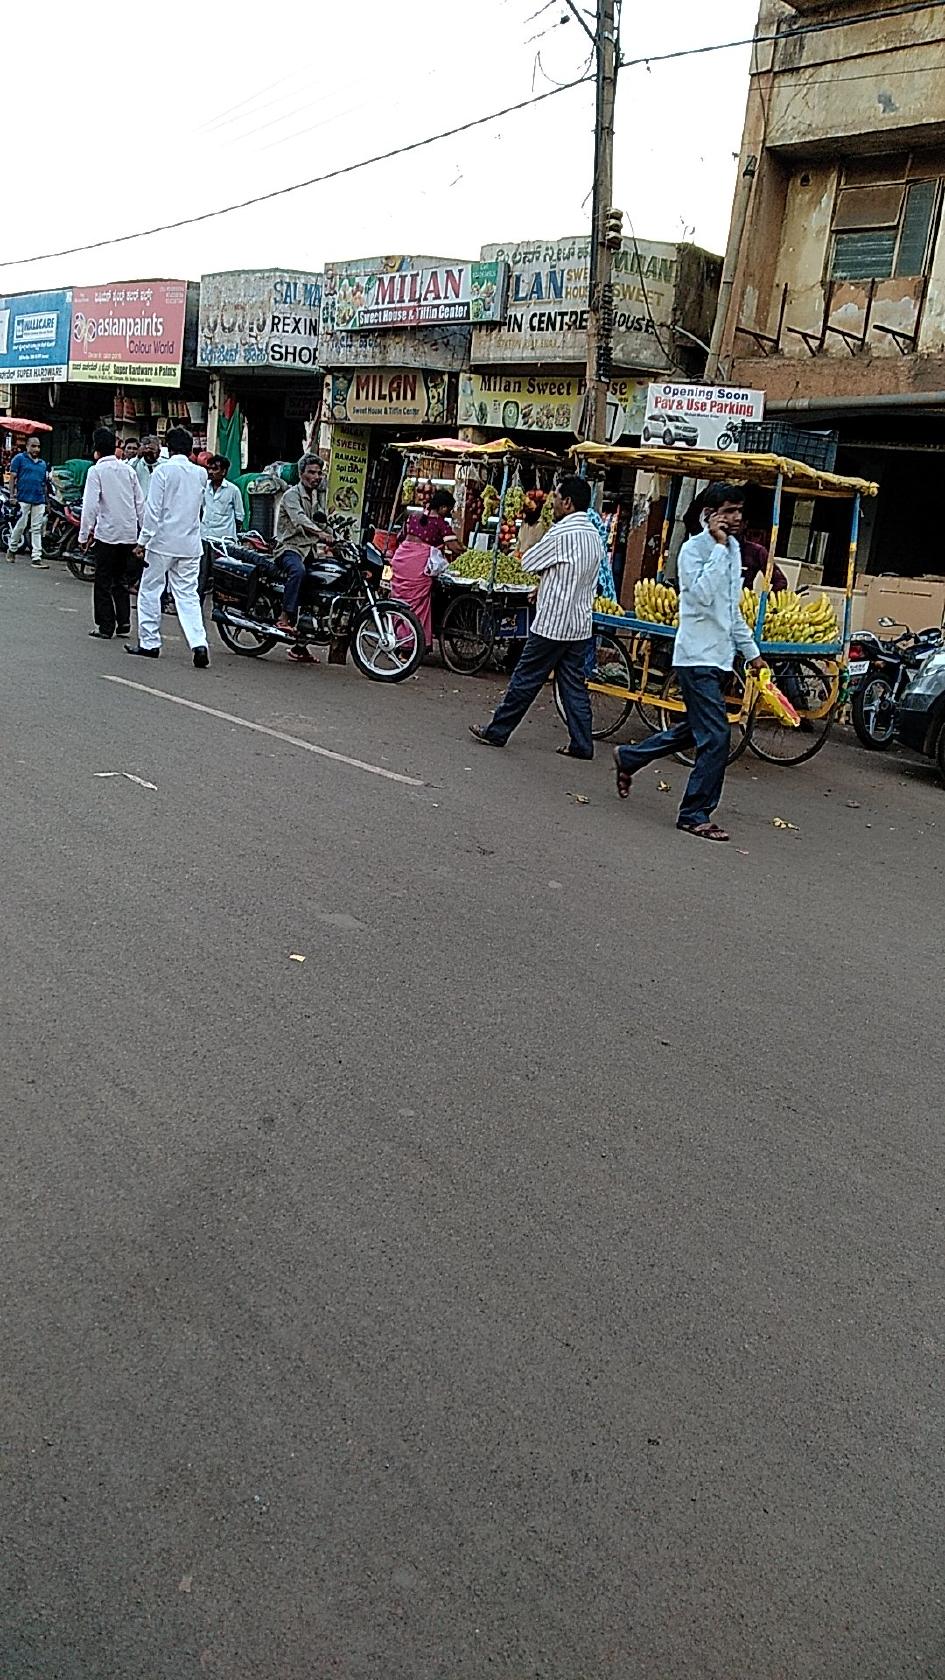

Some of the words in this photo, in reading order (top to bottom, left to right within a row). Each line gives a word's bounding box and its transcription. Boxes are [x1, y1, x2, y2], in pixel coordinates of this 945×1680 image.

[374, 268, 464, 306] MILAN
[513, 268, 565, 302] LAN
[612, 282, 665, 306] SWEET
[270, 314, 318, 336] REXIN
[359, 310, 382, 325] Sweet
[383, 308, 407, 321] House
[416, 306, 438, 320] Tiffin
[439, 305, 468, 318] Center
[529, 310, 590, 333] CENTRE
[97, 310, 164, 348] asianpaints
[129, 340, 152, 354] Colour
[153, 340, 175, 354] World
[16, 368, 32, 378] SUPER
[33, 367, 63, 377] HARDWARE
[113, 363, 128, 375] Super
[129, 364, 153, 376] Hardware
[158, 365, 177, 377] Paints
[355, 374, 418, 403] MILAN
[479, 375, 522, 393] Milan
[527, 377, 572, 396] Sweet
[577, 379, 628, 396] Hse
[662, 385, 714, 400] Opening
[717, 388, 749, 401] Soon
[654, 395, 675, 411] Pay
[676, 399, 684, 410] &
[686, 398, 707, 412] Use
[709, 400, 754, 417] Parking
[336, 438, 367, 452] SWEETS
